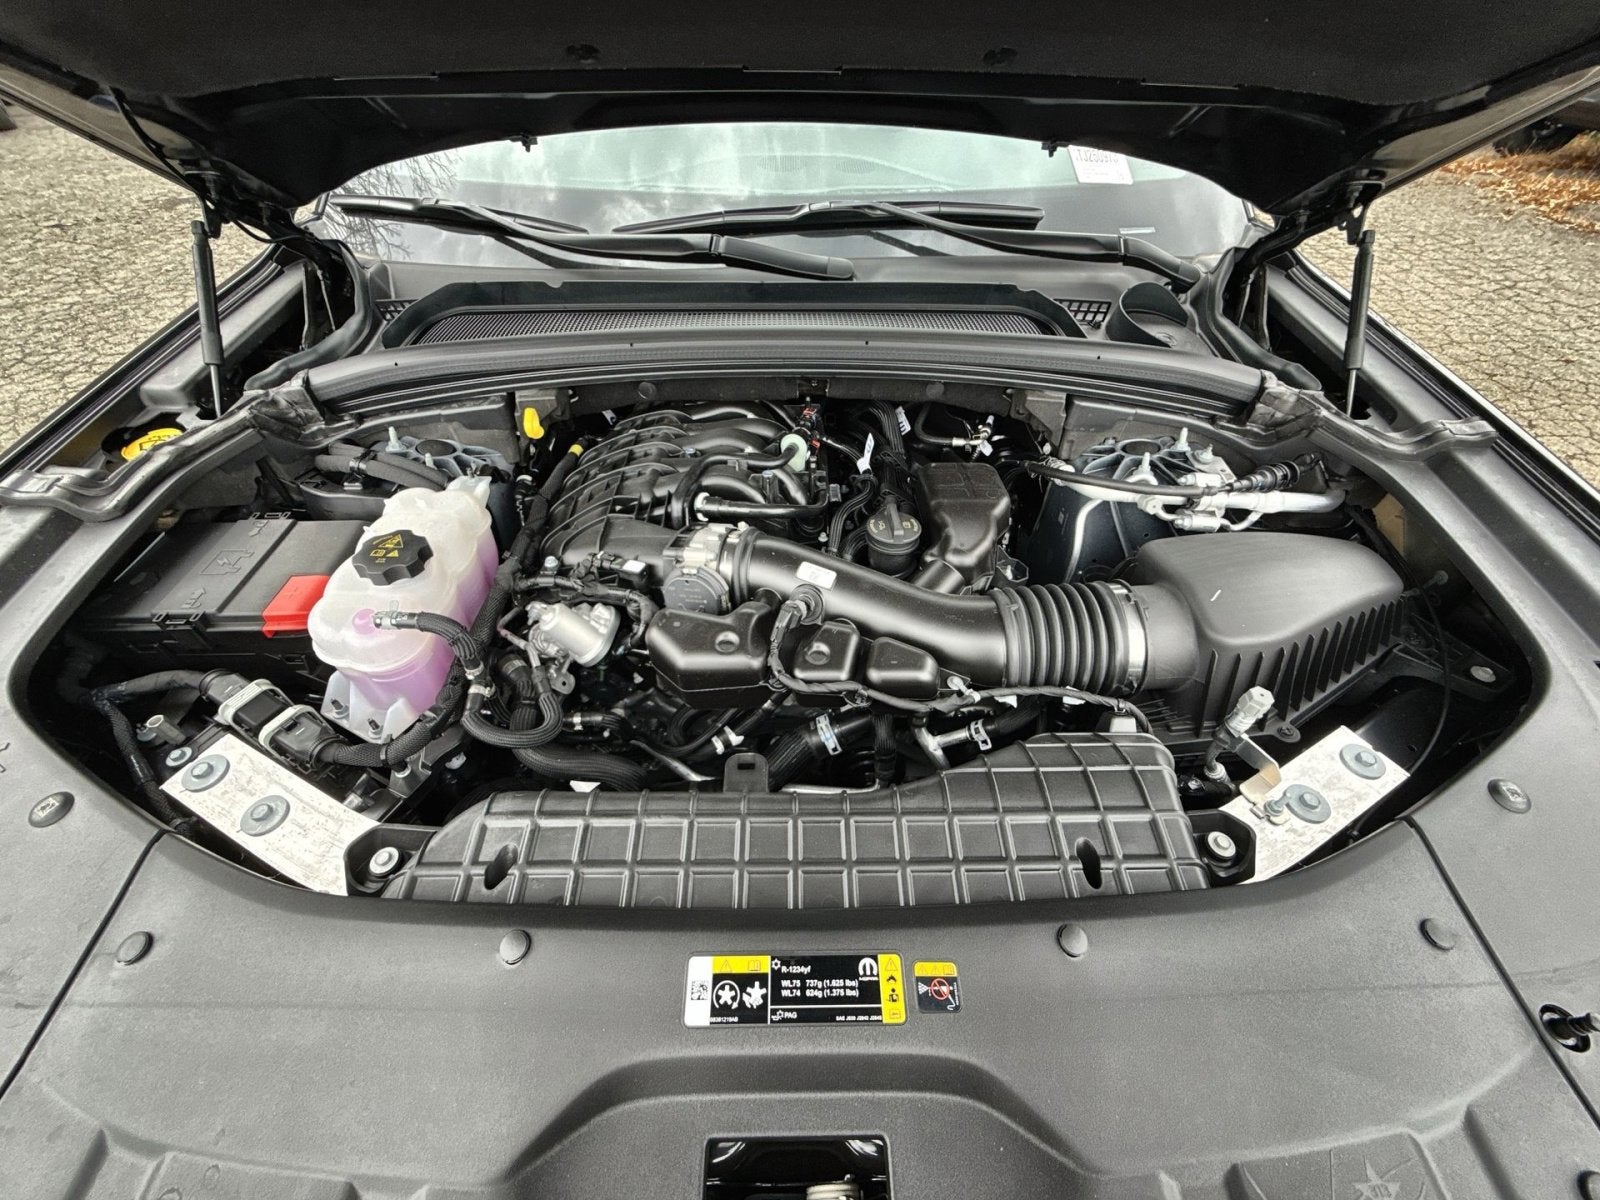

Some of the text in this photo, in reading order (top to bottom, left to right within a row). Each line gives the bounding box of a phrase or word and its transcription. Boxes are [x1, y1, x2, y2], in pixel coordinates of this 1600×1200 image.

[781, 965, 811, 974] R-1234yf
[781, 979, 801, 988] WL75
[805, 979, 822, 988] 737g
[845, 979, 859, 988] lbs)
[781, 989, 859, 998] WL74 624g (1.375 lbs)
[784, 1011, 798, 1019] PAG
